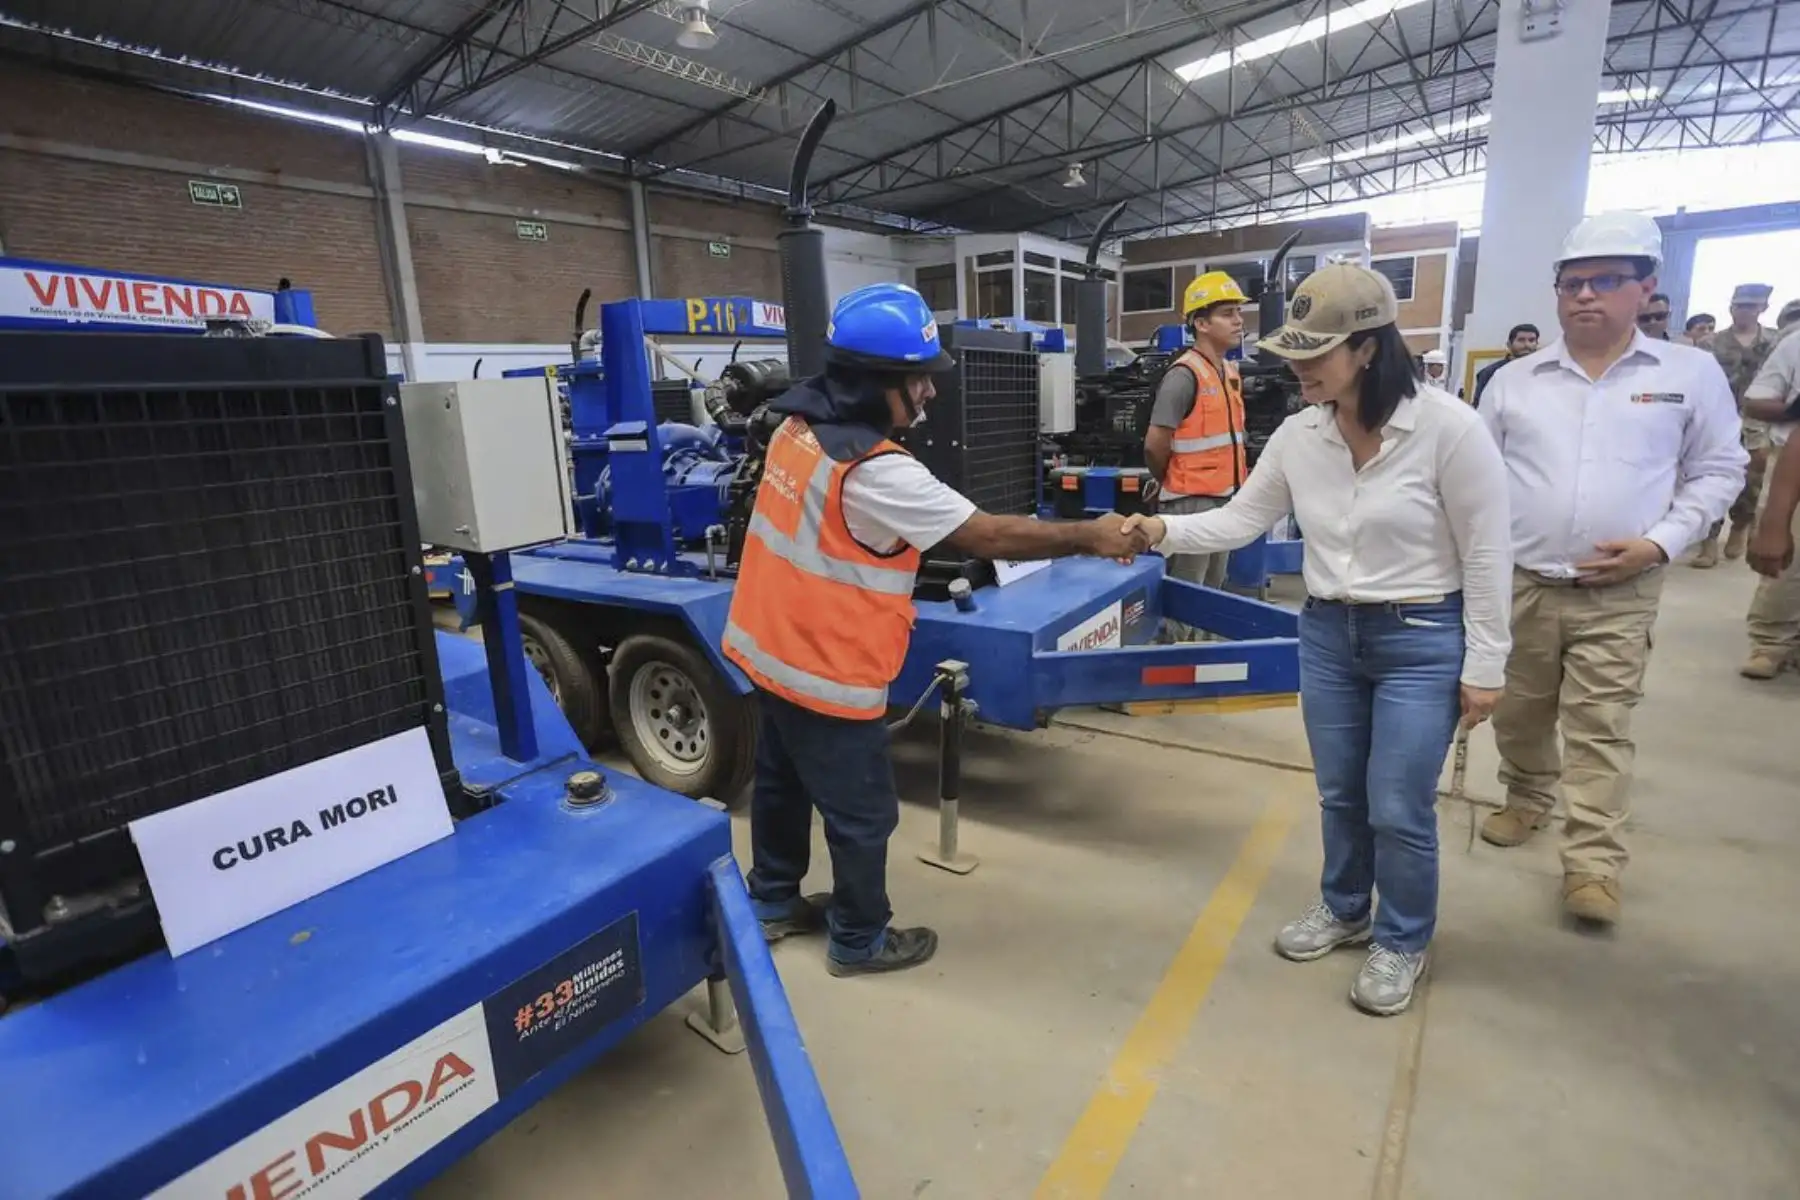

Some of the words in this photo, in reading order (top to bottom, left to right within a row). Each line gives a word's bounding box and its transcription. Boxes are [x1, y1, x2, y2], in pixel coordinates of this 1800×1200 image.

[24, 272, 252, 318] VIVIENDA
[30, 306, 82, 318] Ministerio
[212, 819, 313, 871] CURA
[318, 784, 398, 831] MORI
[514, 979, 574, 1033] #33
[572, 948, 622, 983] Millones
[574, 959, 625, 996] Unidos
[518, 1016, 552, 1042] Ante
[555, 1016, 566, 1032] El
[393, 1077, 476, 1133] Saneamiento
